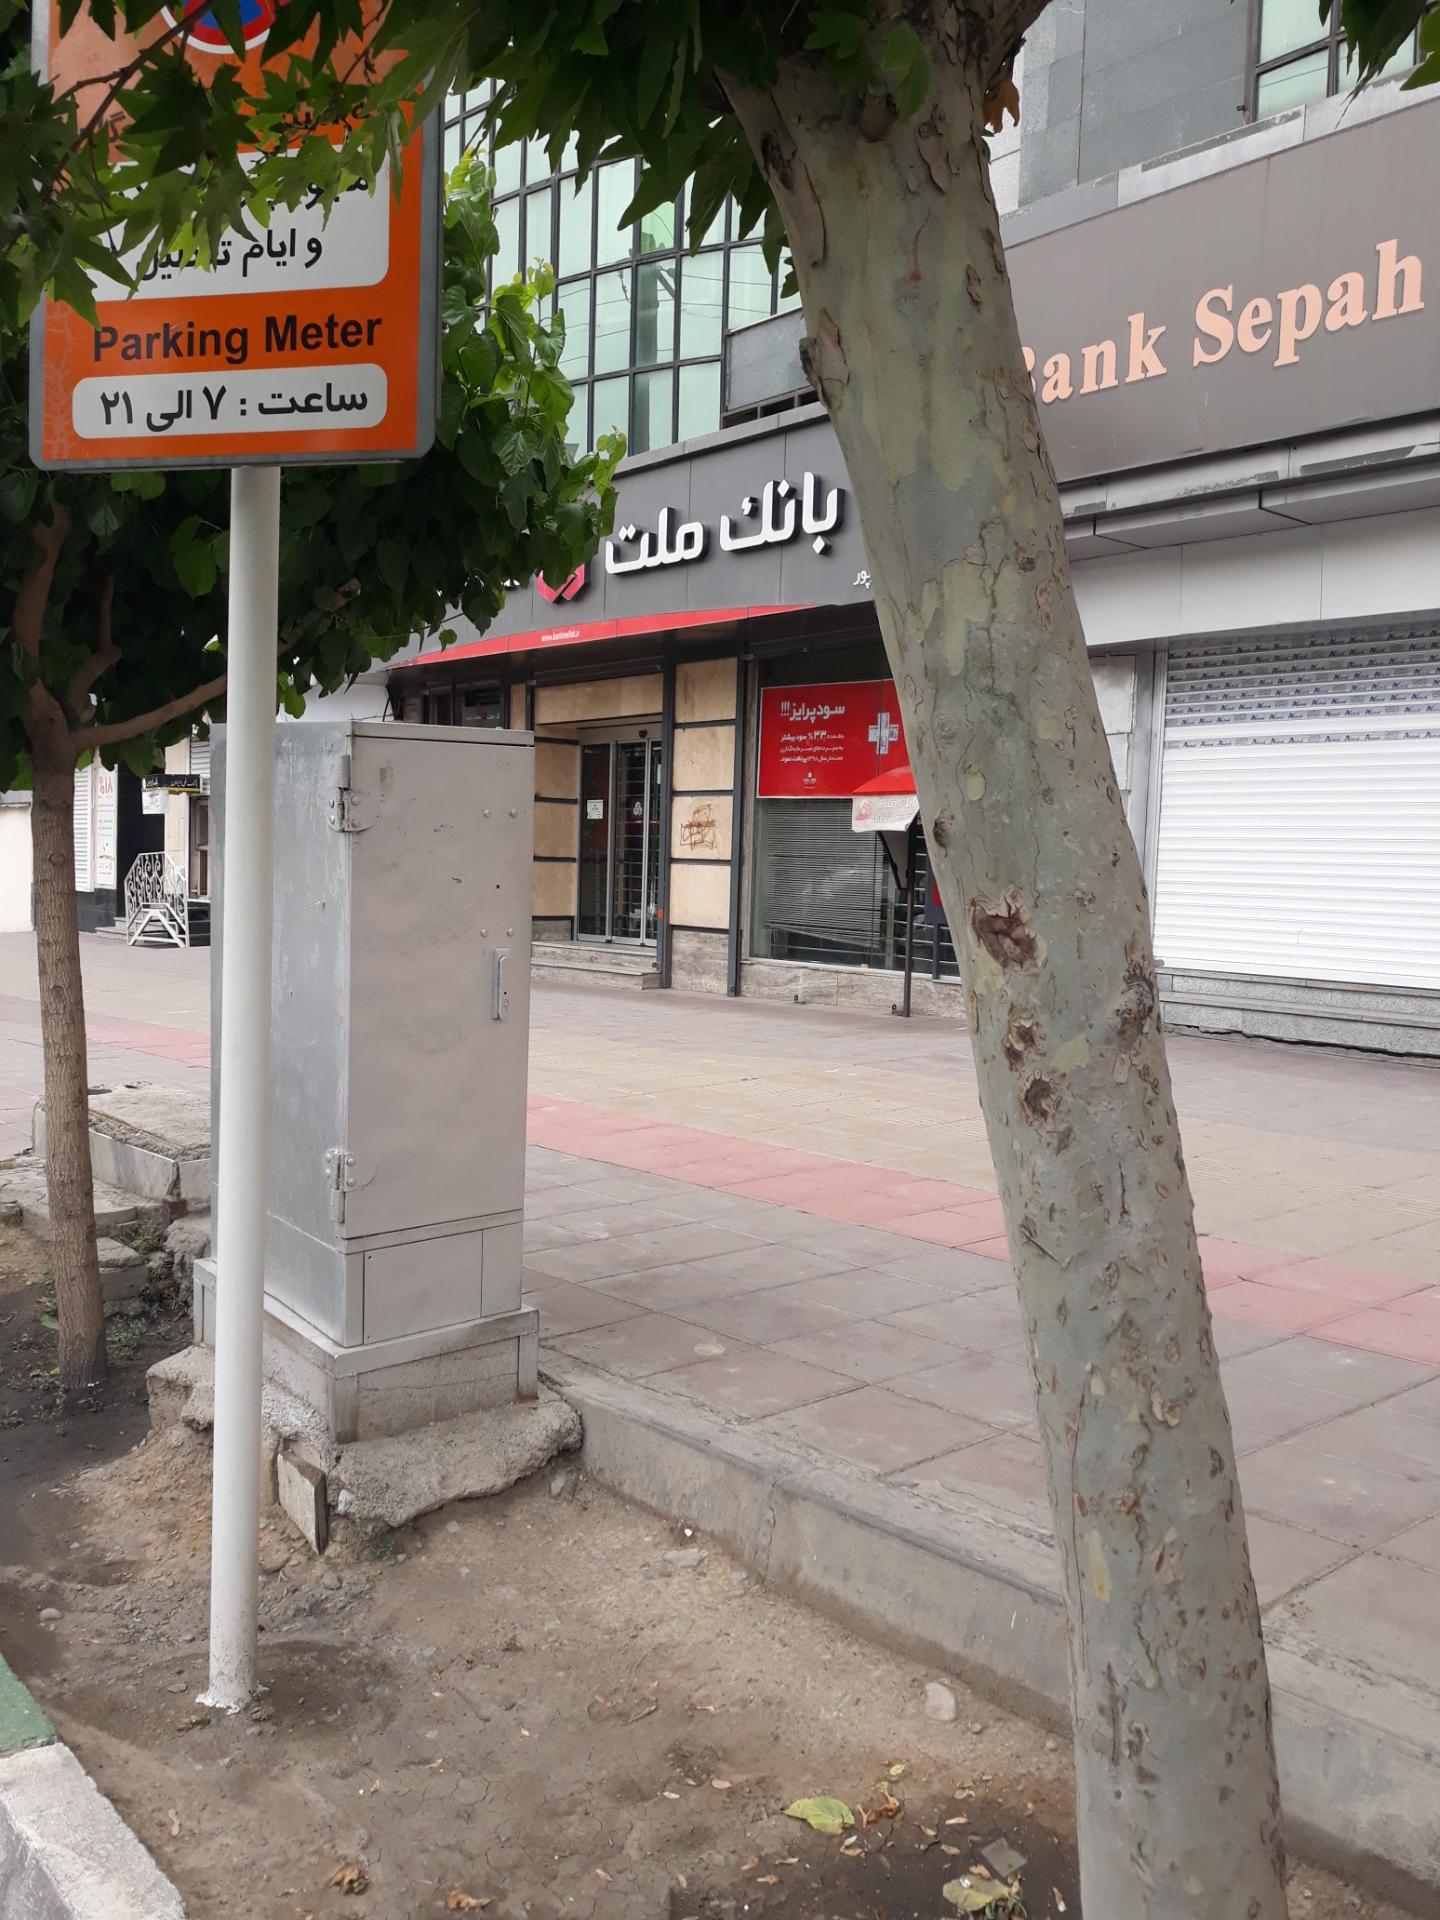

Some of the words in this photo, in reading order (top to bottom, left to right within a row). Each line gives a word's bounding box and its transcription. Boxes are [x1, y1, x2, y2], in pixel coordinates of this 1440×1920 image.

[242, 228, 296, 277] ایام
[304, 237, 323, 268] و
[1192, 238, 1425, 367] Sepah
[93, 320, 249, 365] Parking
[265, 314, 382, 354] Meter
[100, 390, 133, 425] ۲۱
[146, 389, 192, 432] الی
[202, 385, 227, 419] ۷
[720, 472, 842, 555] بانک
[605, 507, 707, 575] ملت
